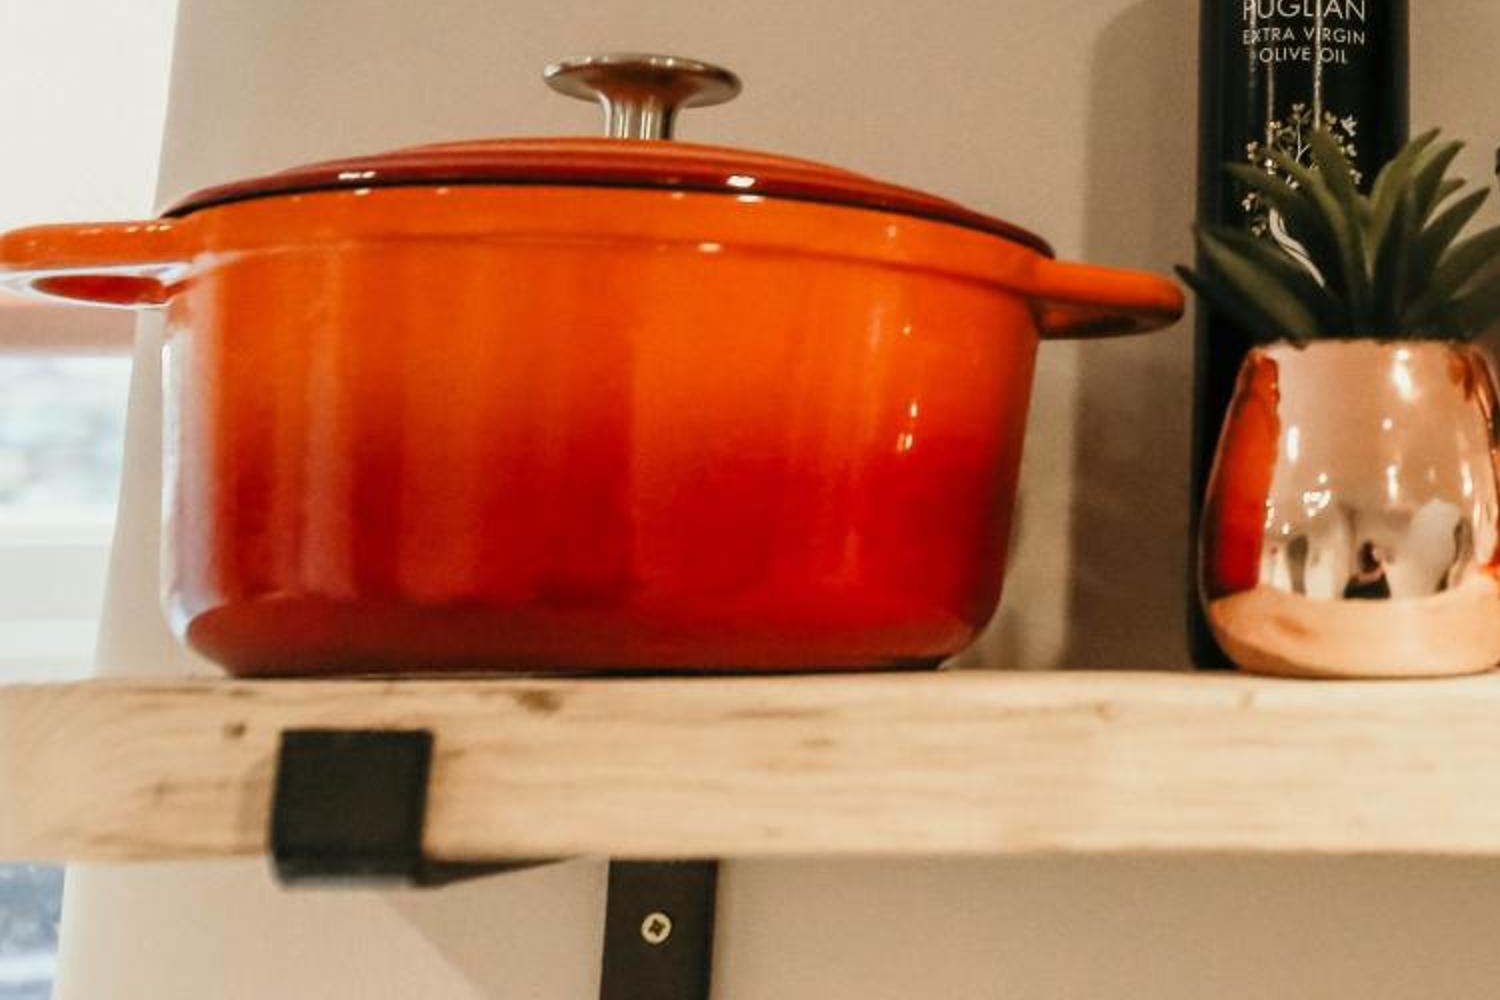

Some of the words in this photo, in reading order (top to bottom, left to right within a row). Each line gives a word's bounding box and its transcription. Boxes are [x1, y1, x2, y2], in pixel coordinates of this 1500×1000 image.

[1243, 27, 1295, 45] EXTRA
[1303, 27, 1365, 45] VIRGIN
[1259, 47, 1311, 63] OLIVE
[1319, 47, 1349, 65] OIL
